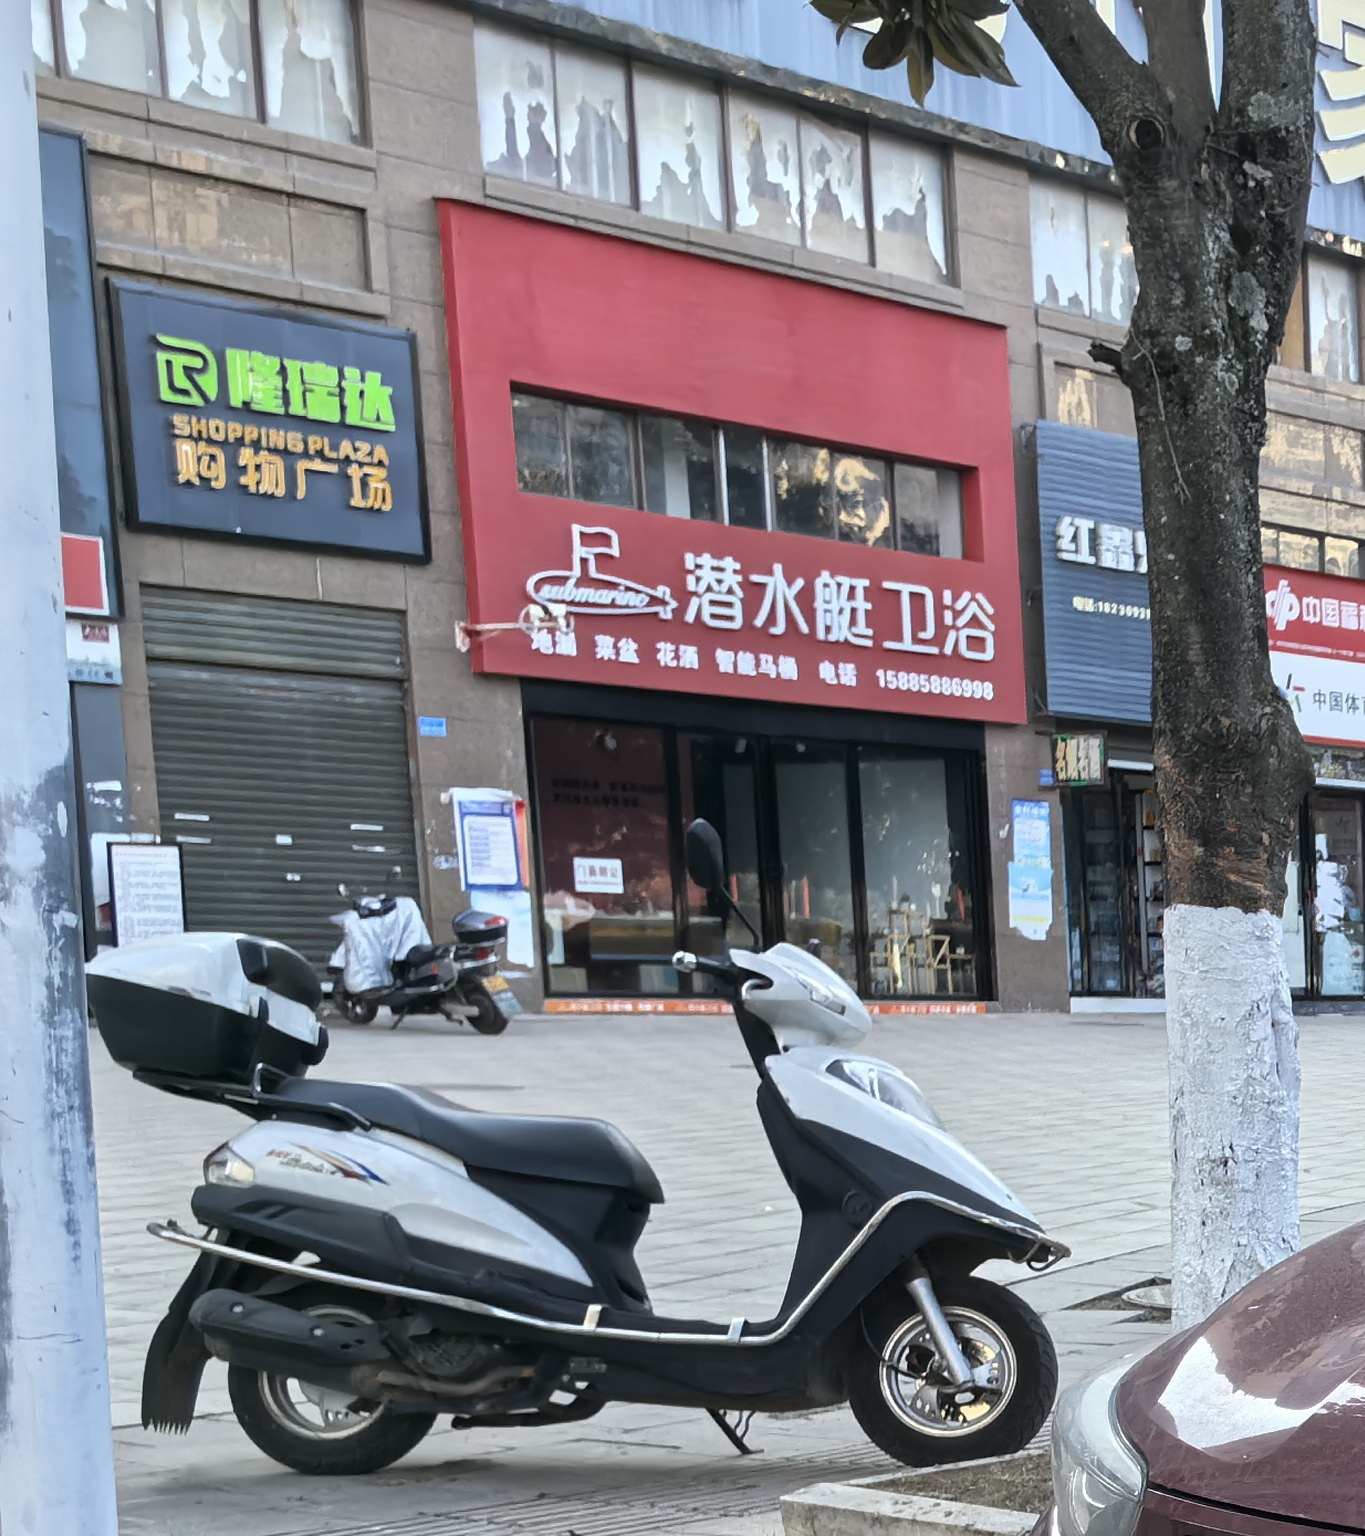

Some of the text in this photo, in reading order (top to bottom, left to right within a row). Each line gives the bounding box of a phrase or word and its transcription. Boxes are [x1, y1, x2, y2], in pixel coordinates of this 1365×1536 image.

[225, 347, 396, 432] 隆瑞达
[172, 412, 389, 467] SHOPPING PLAZA
[175, 438, 393, 511] 购物广场
[683, 551, 996, 662] 潜水艇卫浴
